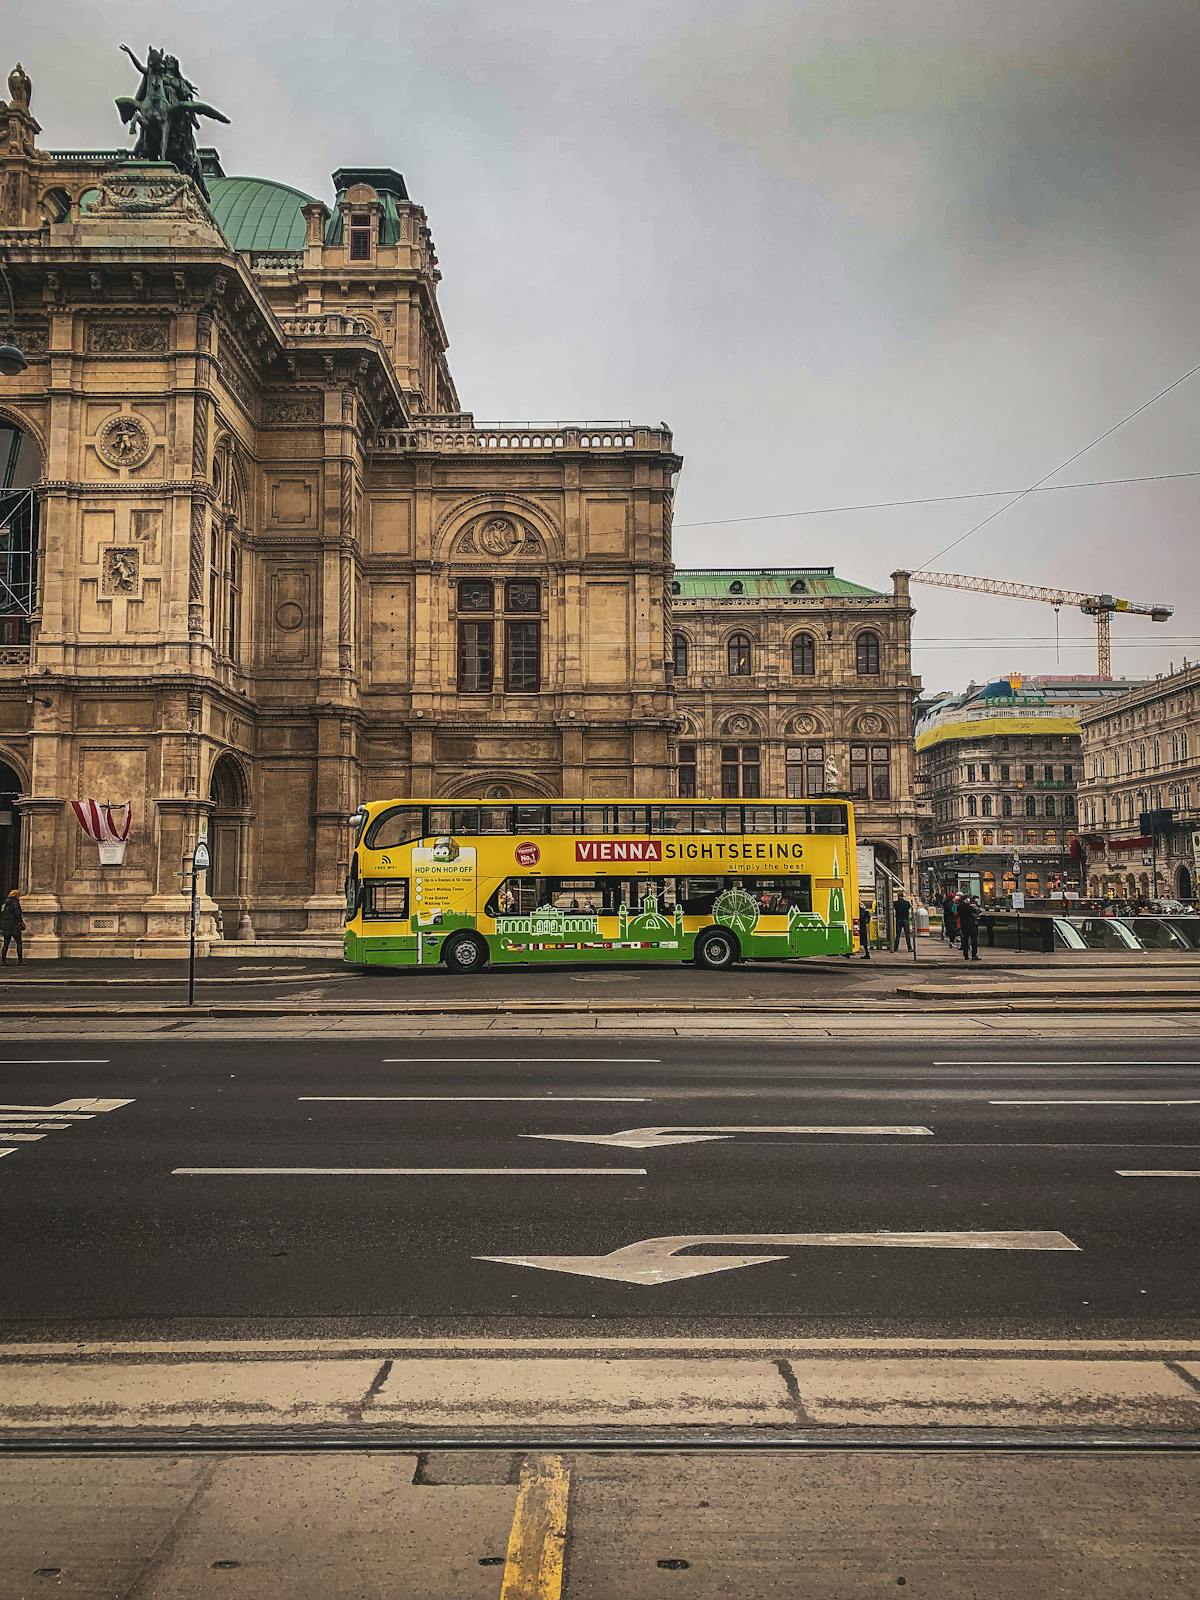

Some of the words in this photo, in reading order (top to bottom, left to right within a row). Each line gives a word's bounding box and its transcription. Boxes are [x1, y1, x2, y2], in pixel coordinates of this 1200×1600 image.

[985, 696, 1046, 706] ROLEX
[577, 843, 658, 859] VIENNA
[665, 843, 803, 859] SIGHTSEEING
[728, 863, 760, 871] simply
